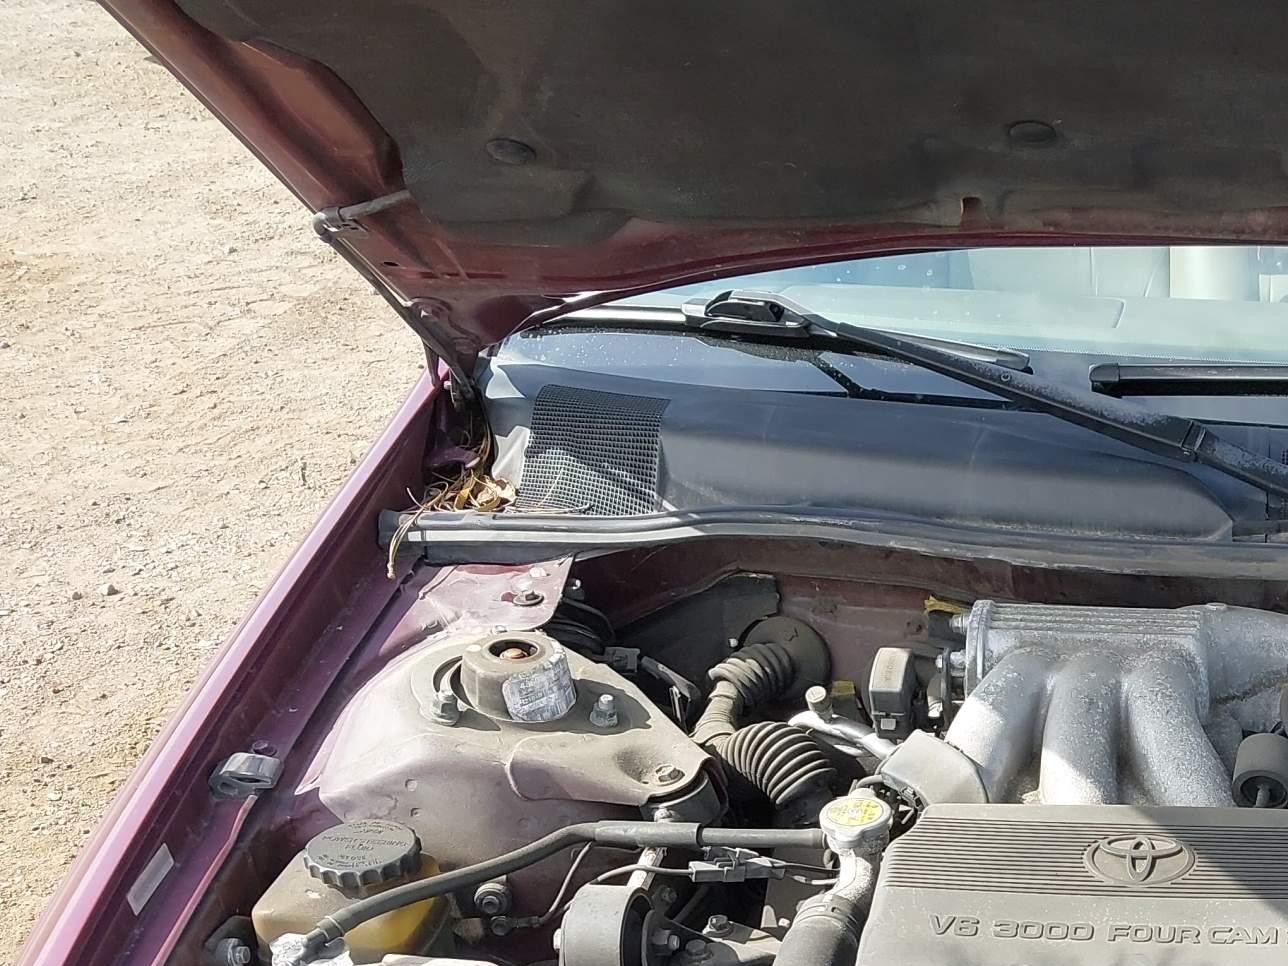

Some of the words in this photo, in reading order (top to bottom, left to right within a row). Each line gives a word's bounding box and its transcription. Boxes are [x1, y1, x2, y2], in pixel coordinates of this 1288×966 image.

[930, 915, 980, 937] V6
[993, 921, 1095, 941] 3000
[1107, 925, 1201, 944] FOUR
[1208, 926, 1278, 944] CAM
